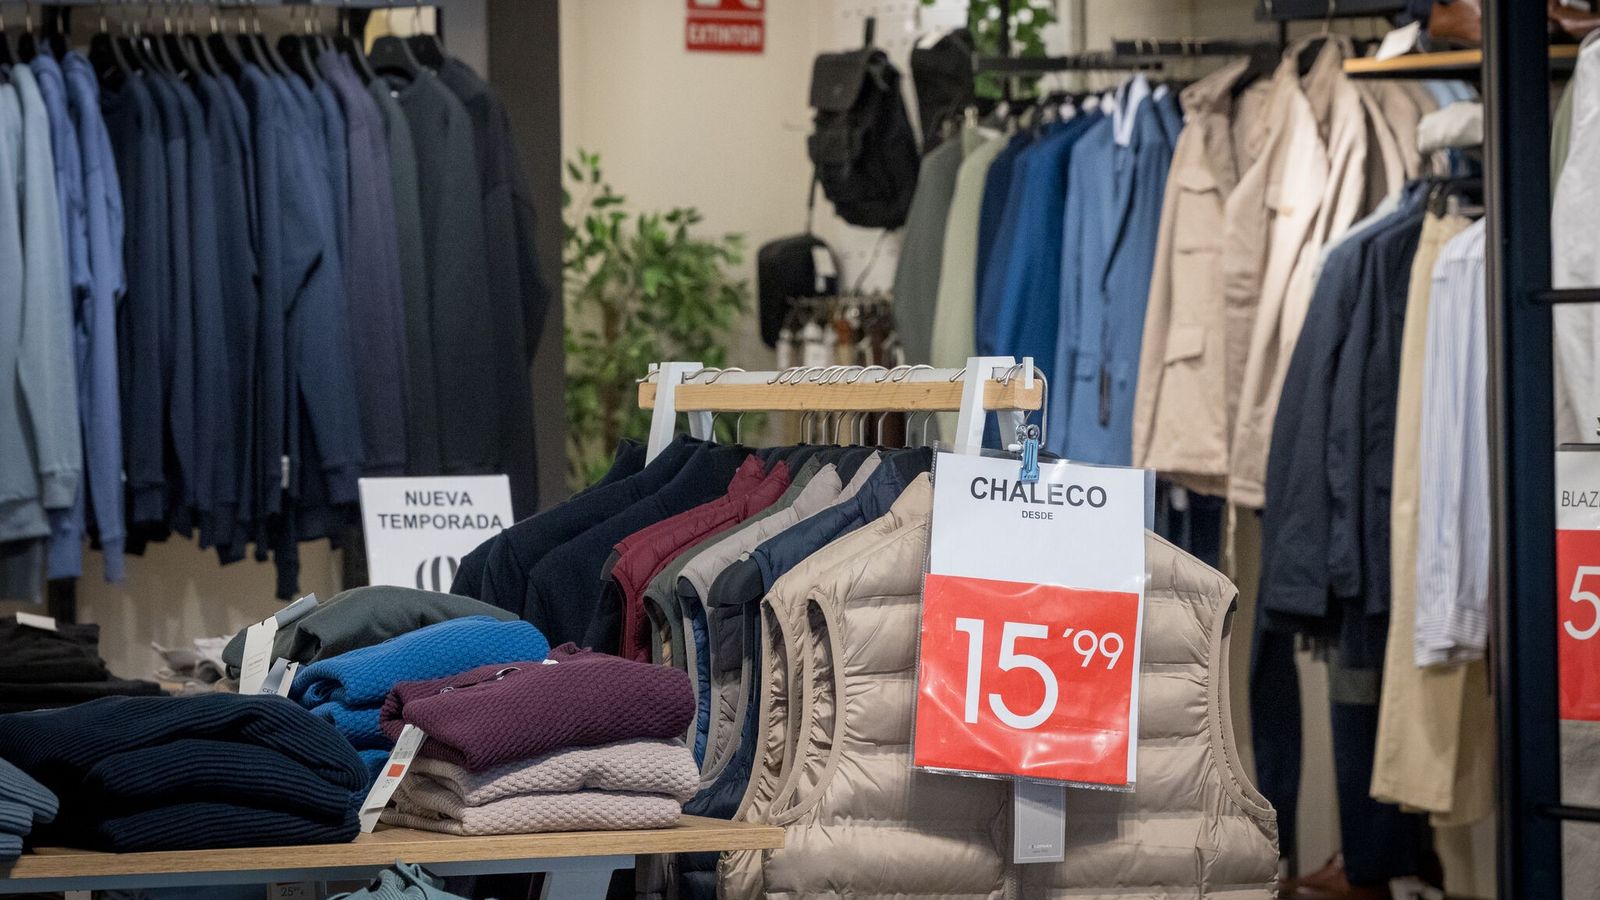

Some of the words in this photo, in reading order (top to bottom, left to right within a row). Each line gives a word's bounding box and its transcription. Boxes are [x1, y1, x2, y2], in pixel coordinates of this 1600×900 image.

[404, 491, 473, 507] NUEVA
[970, 476, 1107, 508] CHALECO
[1561, 490, 1600, 508] BLAZ
[377, 513, 504, 530] TEMPORADA
[1021, 510, 1054, 520] DESDE
